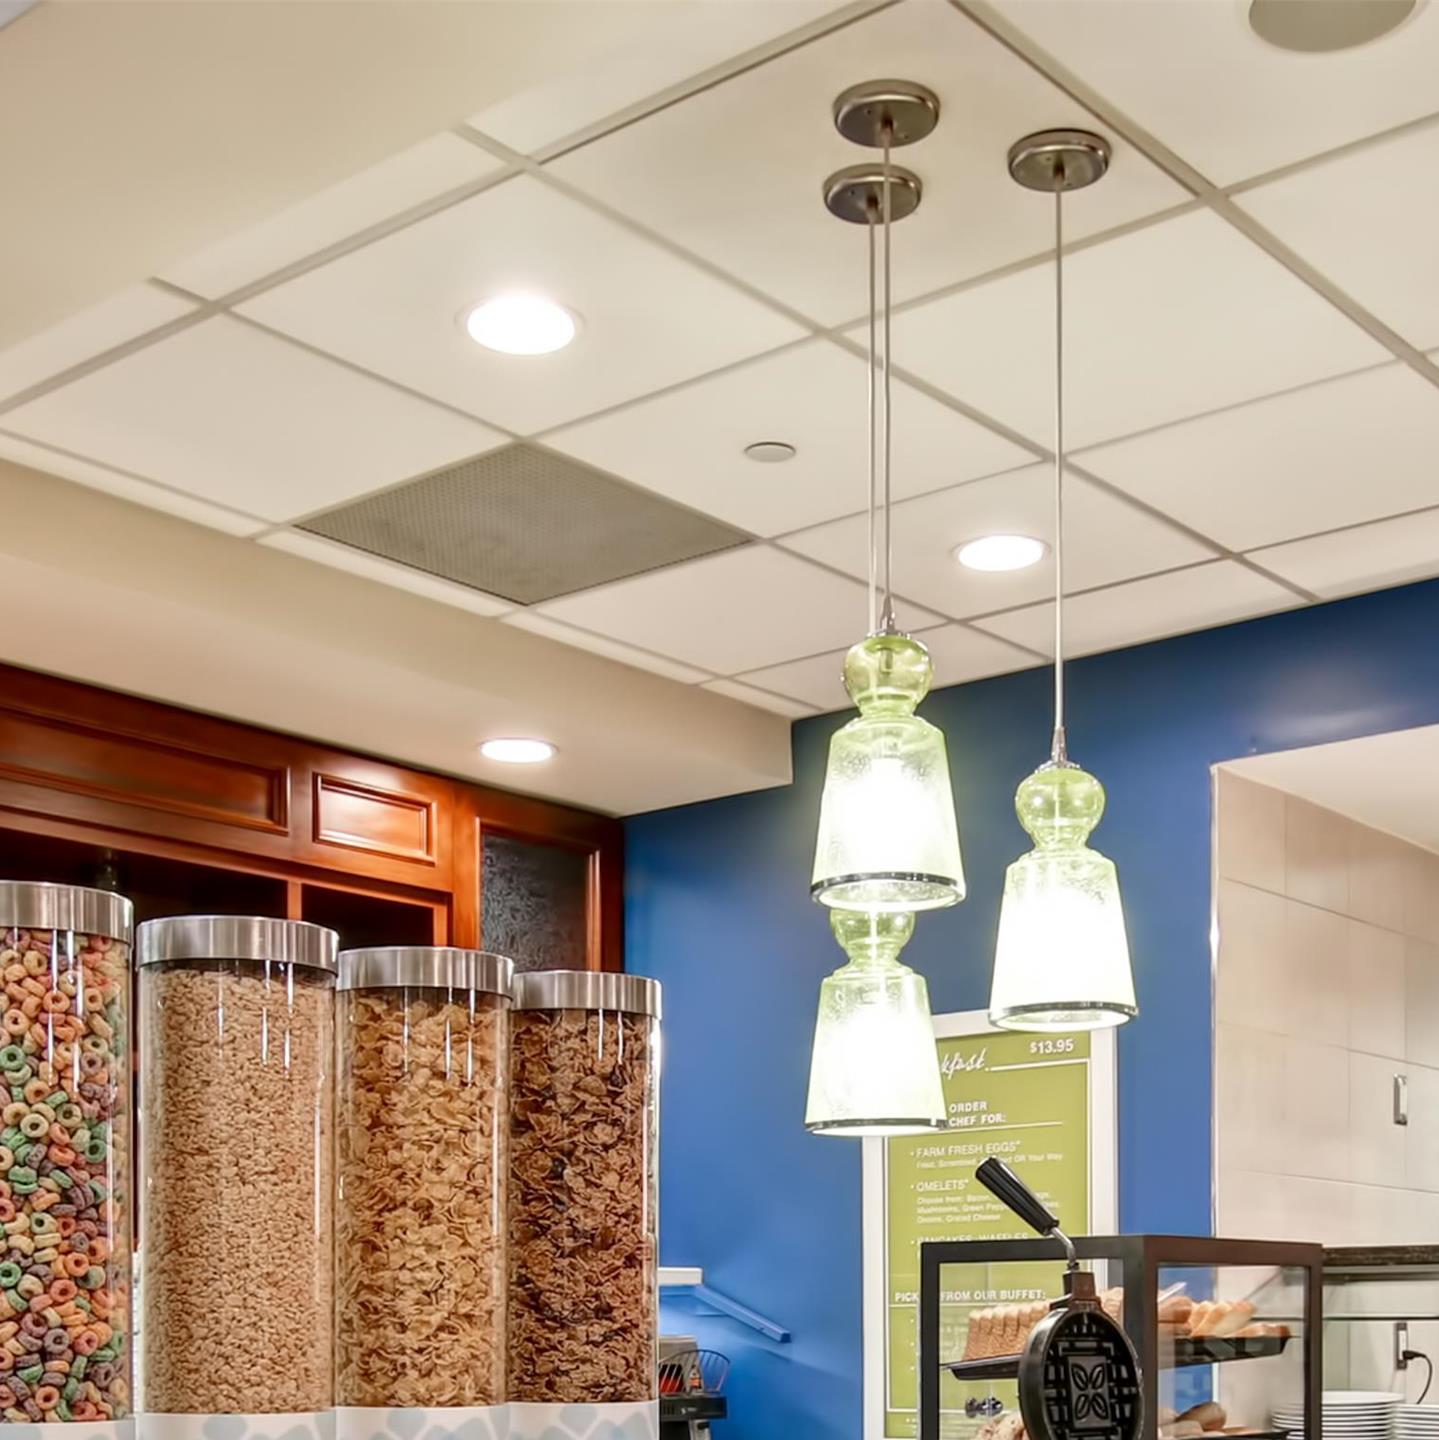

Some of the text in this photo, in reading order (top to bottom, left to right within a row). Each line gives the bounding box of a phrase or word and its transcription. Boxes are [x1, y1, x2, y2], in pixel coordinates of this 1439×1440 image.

[1030, 1038, 1074, 1054] $13.95
[949, 1101, 987, 1113] ORDER
[948, 1113, 1007, 1127] CHEF FOR:
[917, 1145, 945, 1157] FARM
[948, 1143, 983, 1156] FRESH
[895, 1288, 1046, 1301] PICK FROM OUR BUFFET:
